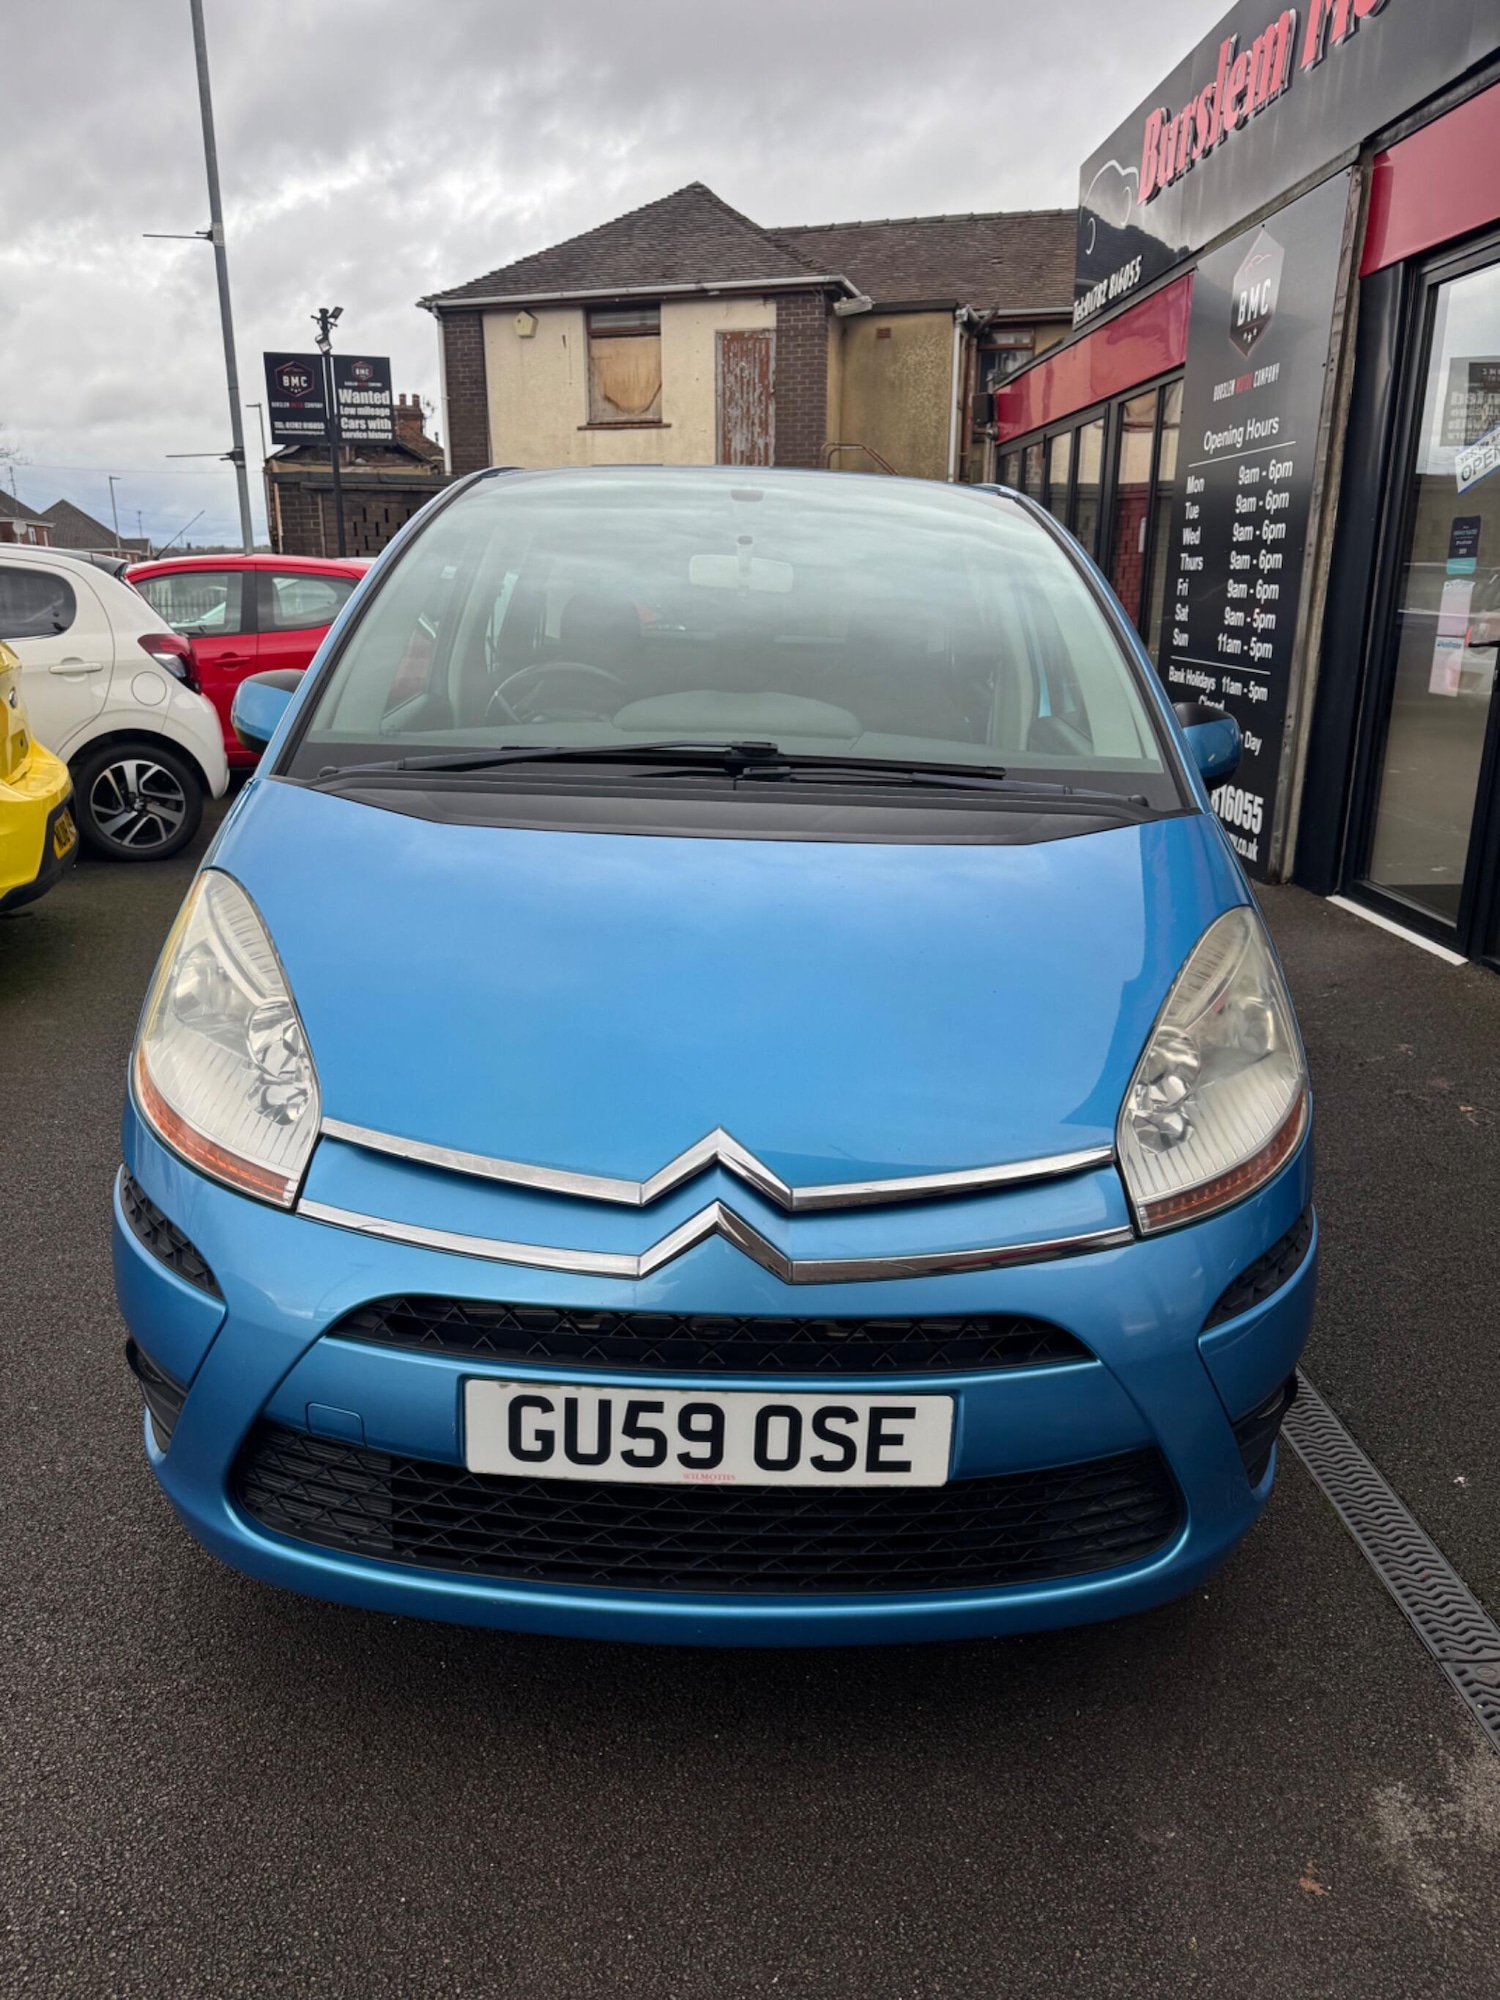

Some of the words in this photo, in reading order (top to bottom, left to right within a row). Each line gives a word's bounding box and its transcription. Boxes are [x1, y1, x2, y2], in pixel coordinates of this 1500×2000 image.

[1137, 8, 1298, 206] Burslem
[1237, 278, 1271, 326] BMC
[282, 375, 308, 387] BMC
[338, 388, 390, 404] Wanted
[340, 405, 356, 415] Low
[356, 406, 390, 417] mileage
[341, 417, 366, 430] Cars
[367, 417, 392, 430] with
[341, 430, 367, 439] service
[367, 430, 392, 440] history
[1204, 424, 1244, 454] Opening
[1246, 417, 1280, 440] Hours
[1186, 476, 1205, 494] Mon
[1238, 465, 1259, 485] 9am
[1269, 459, 1293, 484] 6pm
[1185, 502, 1200, 520] Tue
[1235, 494, 1256, 514] 9am
[1265, 489, 1289, 514] 6pm
[1182, 527, 1201, 546] Wed
[1232, 522, 1253, 542] 9am
[1262, 519, 1286, 544] 6pm
[1180, 553, 1204, 571] Thurs
[1230, 551, 1250, 570] 9am
[1259, 549, 1282, 574] 6pm
[1176, 578, 1189, 596] Fri
[1226, 578, 1248, 598] 9am
[1256, 579, 1279, 604] 6pm
[1175, 603, 1188, 622] Sat
[1224, 606, 1244, 627] 9am
[1252, 608, 1276, 633] 5pm
[1173, 628, 1188, 647] Sun
[1217, 632, 1241, 654] 11am
[1250, 637, 1272, 660] 5pm
[1169, 665, 1186, 684] Bank
[1186, 668, 1216, 694] Holidays
[1222, 676, 1242, 696] 11am
[1248, 681, 1268, 704] 5pm
[1244, 730, 1262, 756] Day
[1211, 784, 1264, 834] 816055
[508, 1393, 726, 1470] GU59
[753, 1404, 917, 1473] OSE
